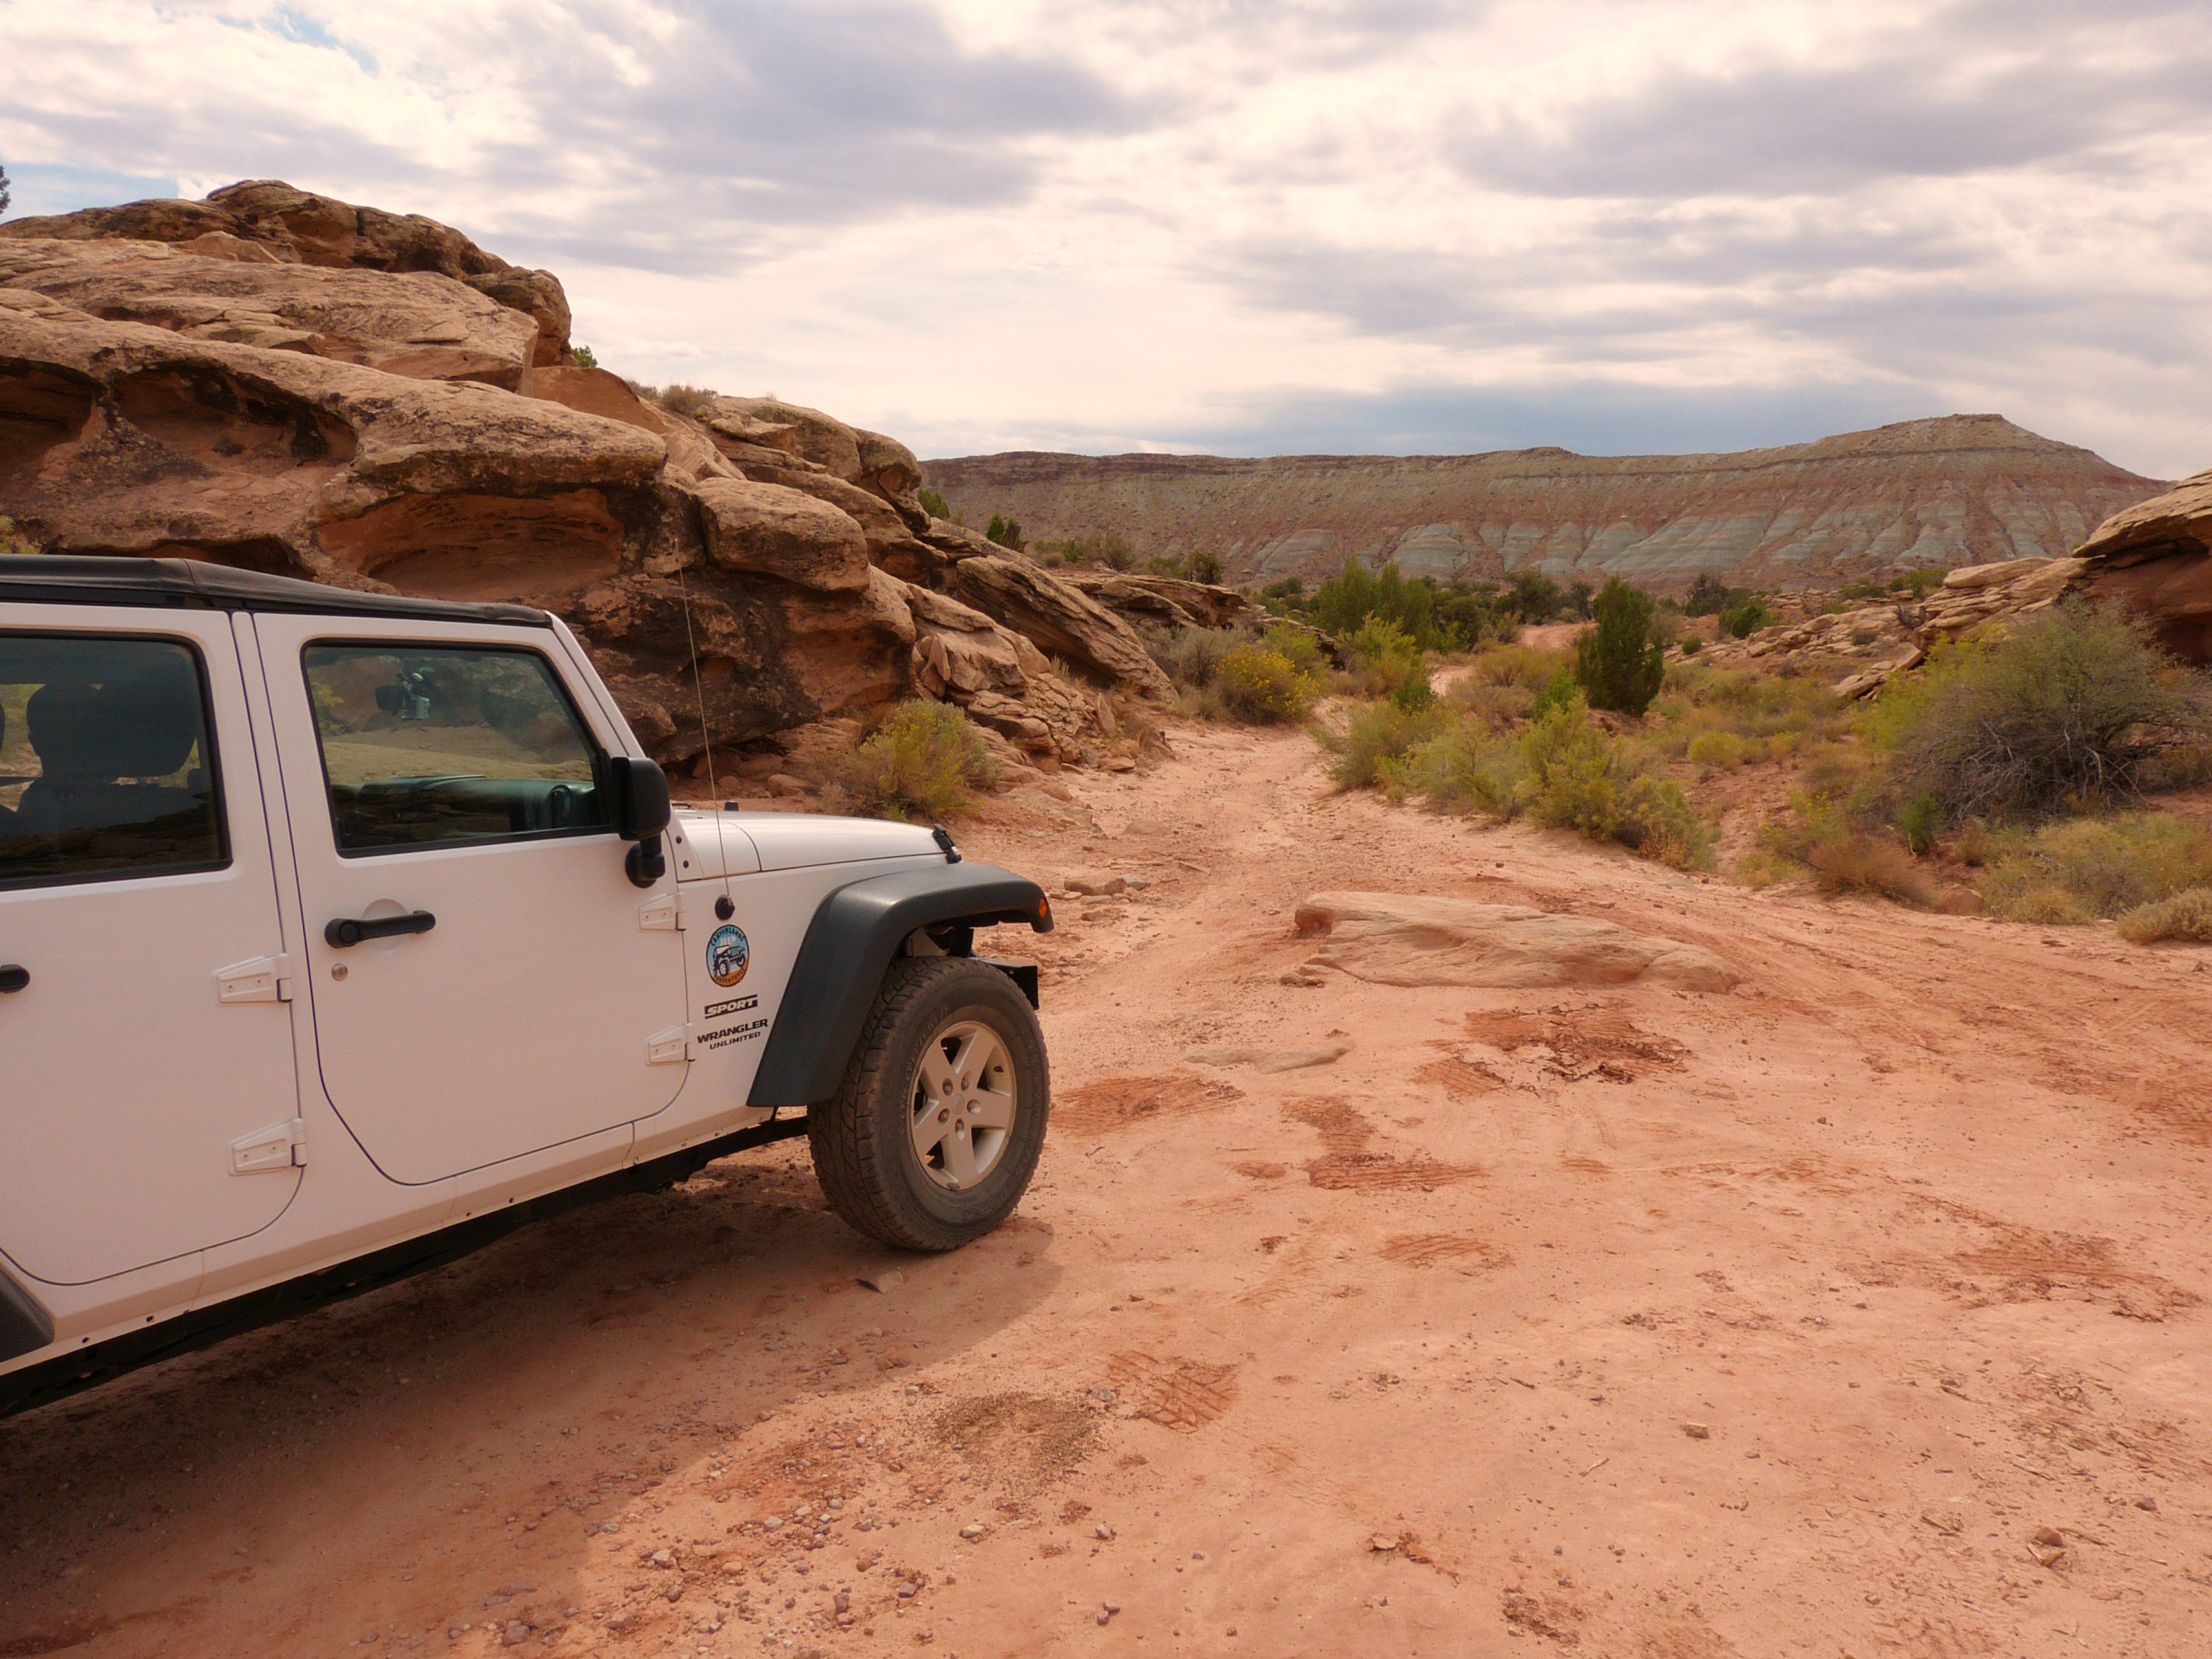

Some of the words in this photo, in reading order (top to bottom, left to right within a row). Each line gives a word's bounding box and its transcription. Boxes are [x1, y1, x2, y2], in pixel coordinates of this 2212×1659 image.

[720, 936, 736, 946] JEEP
[705, 996, 757, 1018] SPORT
[697, 1018, 768, 1044] WRANGLER
[709, 1032, 760, 1050] UNLIMITED
